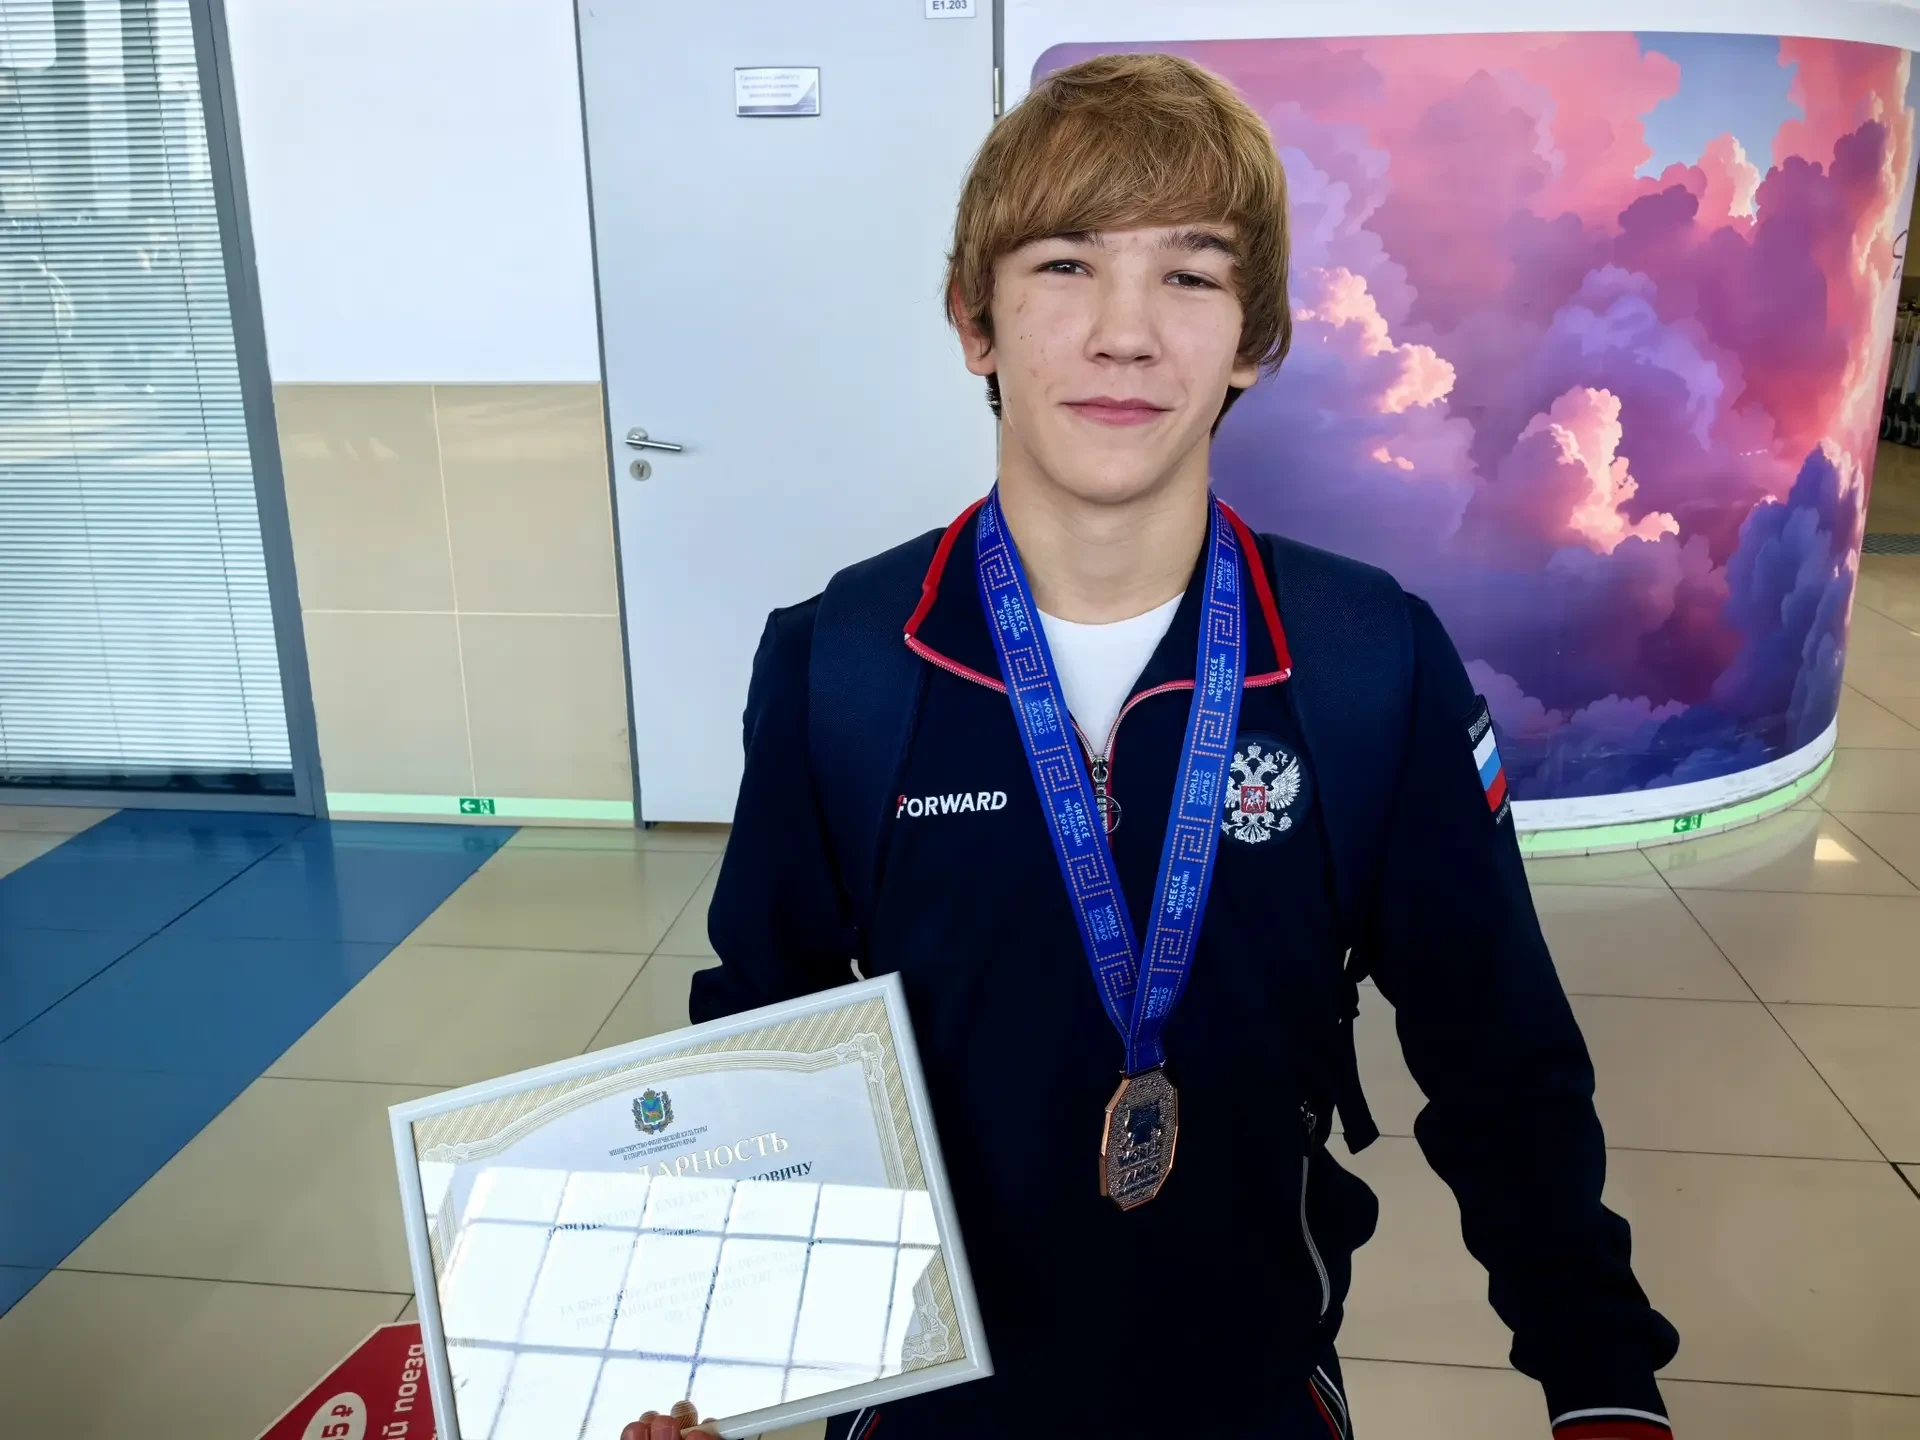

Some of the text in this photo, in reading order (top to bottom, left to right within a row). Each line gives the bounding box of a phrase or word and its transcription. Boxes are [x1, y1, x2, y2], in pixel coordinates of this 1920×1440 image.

[932, 0, 968, 10] E1.203
[1215, 557, 1224, 589] WORLD
[996, 608, 1010, 631] 2026
[1001, 594, 1021, 641] THESSALONIKI
[1011, 597, 1029, 633] GREECE
[1207, 657, 1219, 696] GREECE
[1214, 653, 1226, 703] THESSALONIKI
[1223, 667, 1233, 692] 2026
[1030, 701, 1046, 735] SAMBO
[1041, 697, 1057, 732] WORLD
[1186, 769, 1200, 804] WORLD
[1199, 771, 1212, 806] SAMBO
[896, 791, 1008, 819] FORWARD
[1063, 797, 1083, 847] THESSALONIKI
[1073, 801, 1091, 839] GREECE
[1058, 812, 1071, 836] 2026
[1166, 875, 1182, 914] GREECE
[1174, 870, 1190, 921] THESSALONIKI
[1184, 885, 1196, 909] 2026
[1092, 908, 1108, 941] SAMBO
[1105, 904, 1120, 938] WORLD
[1144, 986, 1158, 1020] WORLD
[608, 1141, 648, 1157] МИНИСТЕРСТВО
[628, 1148, 647, 1160] СПОРТА
[682, 1136, 697, 1147] КРАЯ
